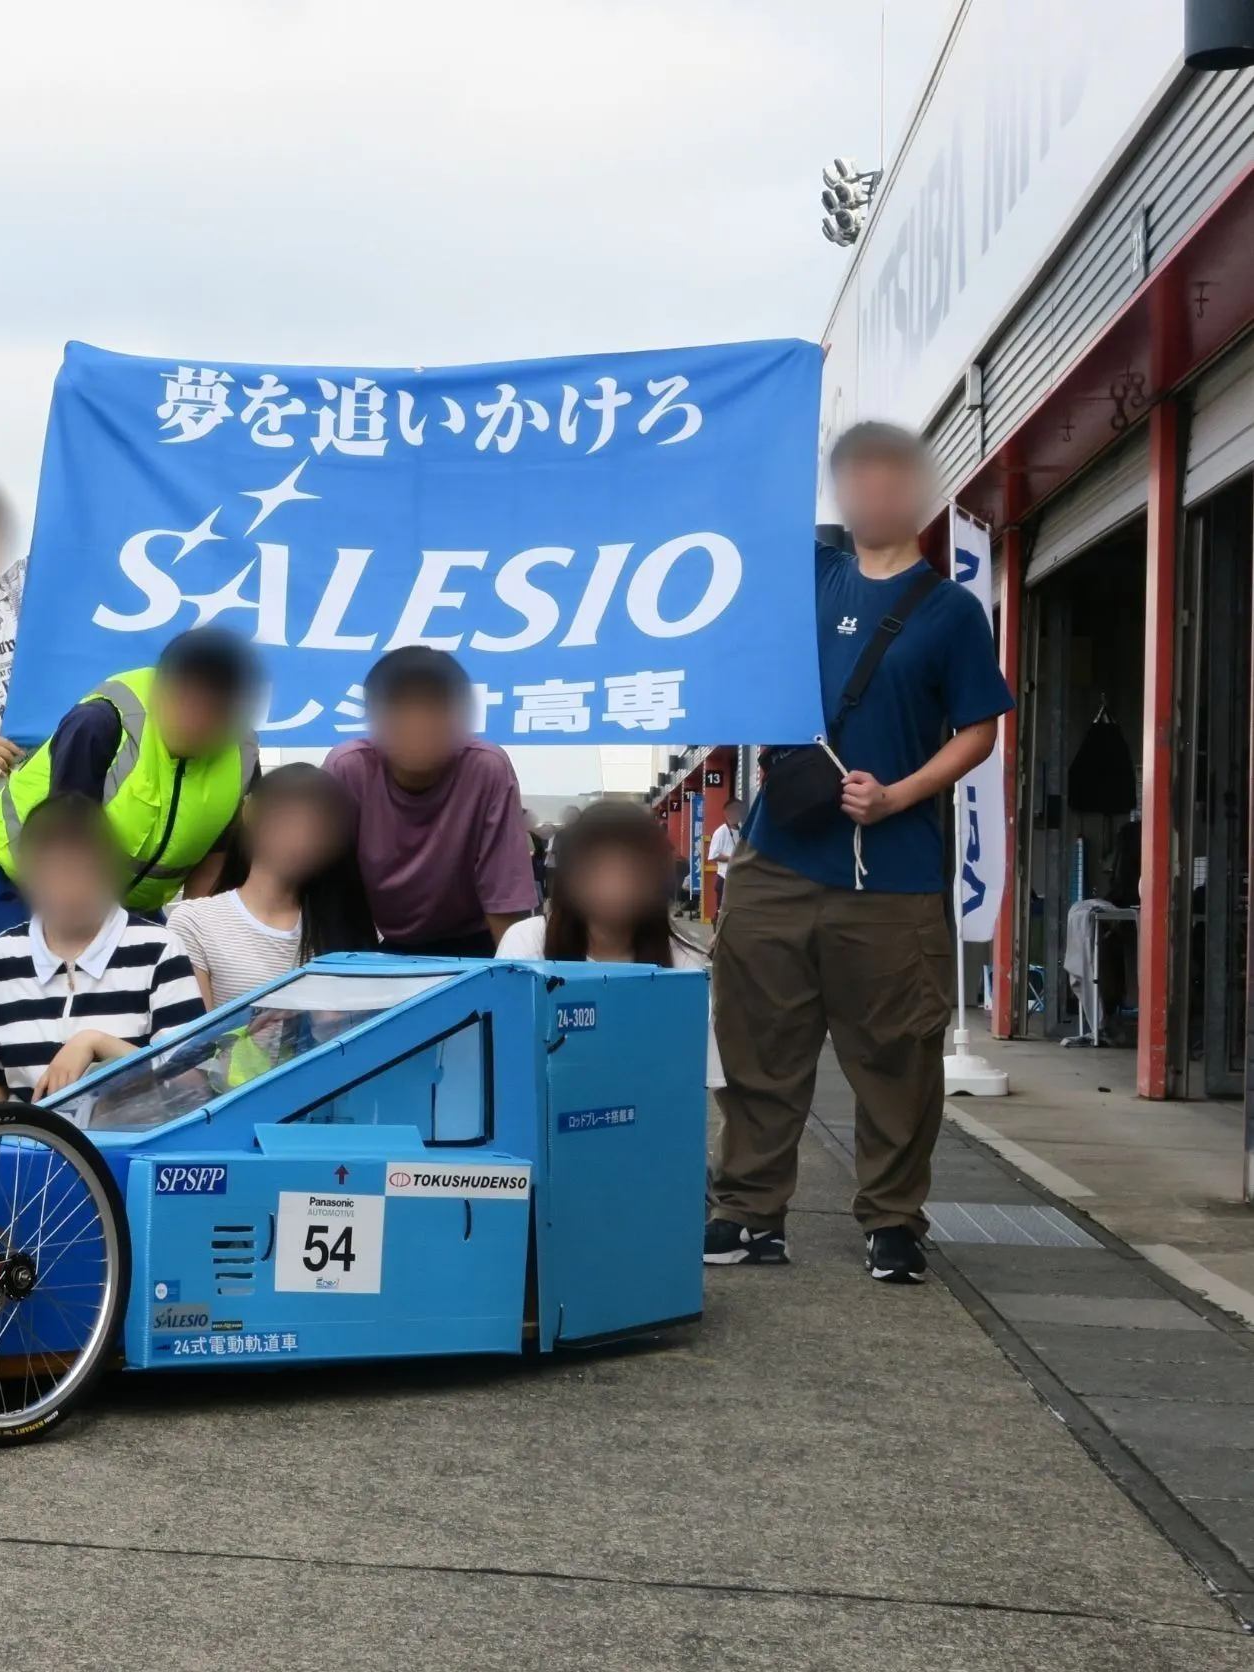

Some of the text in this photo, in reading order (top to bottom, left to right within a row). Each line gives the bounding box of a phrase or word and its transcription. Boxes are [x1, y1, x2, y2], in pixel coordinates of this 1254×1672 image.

[156, 366, 704, 456] 夢を追いかけろ
[92, 528, 743, 652] SALESIO
[707, 773, 721, 784] 13
[557, 1007, 596, 1028] 24-3020
[156, 1167, 226, 1192] SPSFP
[413, 1174, 527, 1189] TOKUSHUDENSO
[309, 1196, 354, 1208] Panasonic
[307, 1208, 355, 1218] AUTOMOTIVE
[302, 1225, 356, 1272] 54
[153, 1309, 209, 1329] SALESIO
[174, 1333, 299, 1355] 24式電動軌道車
